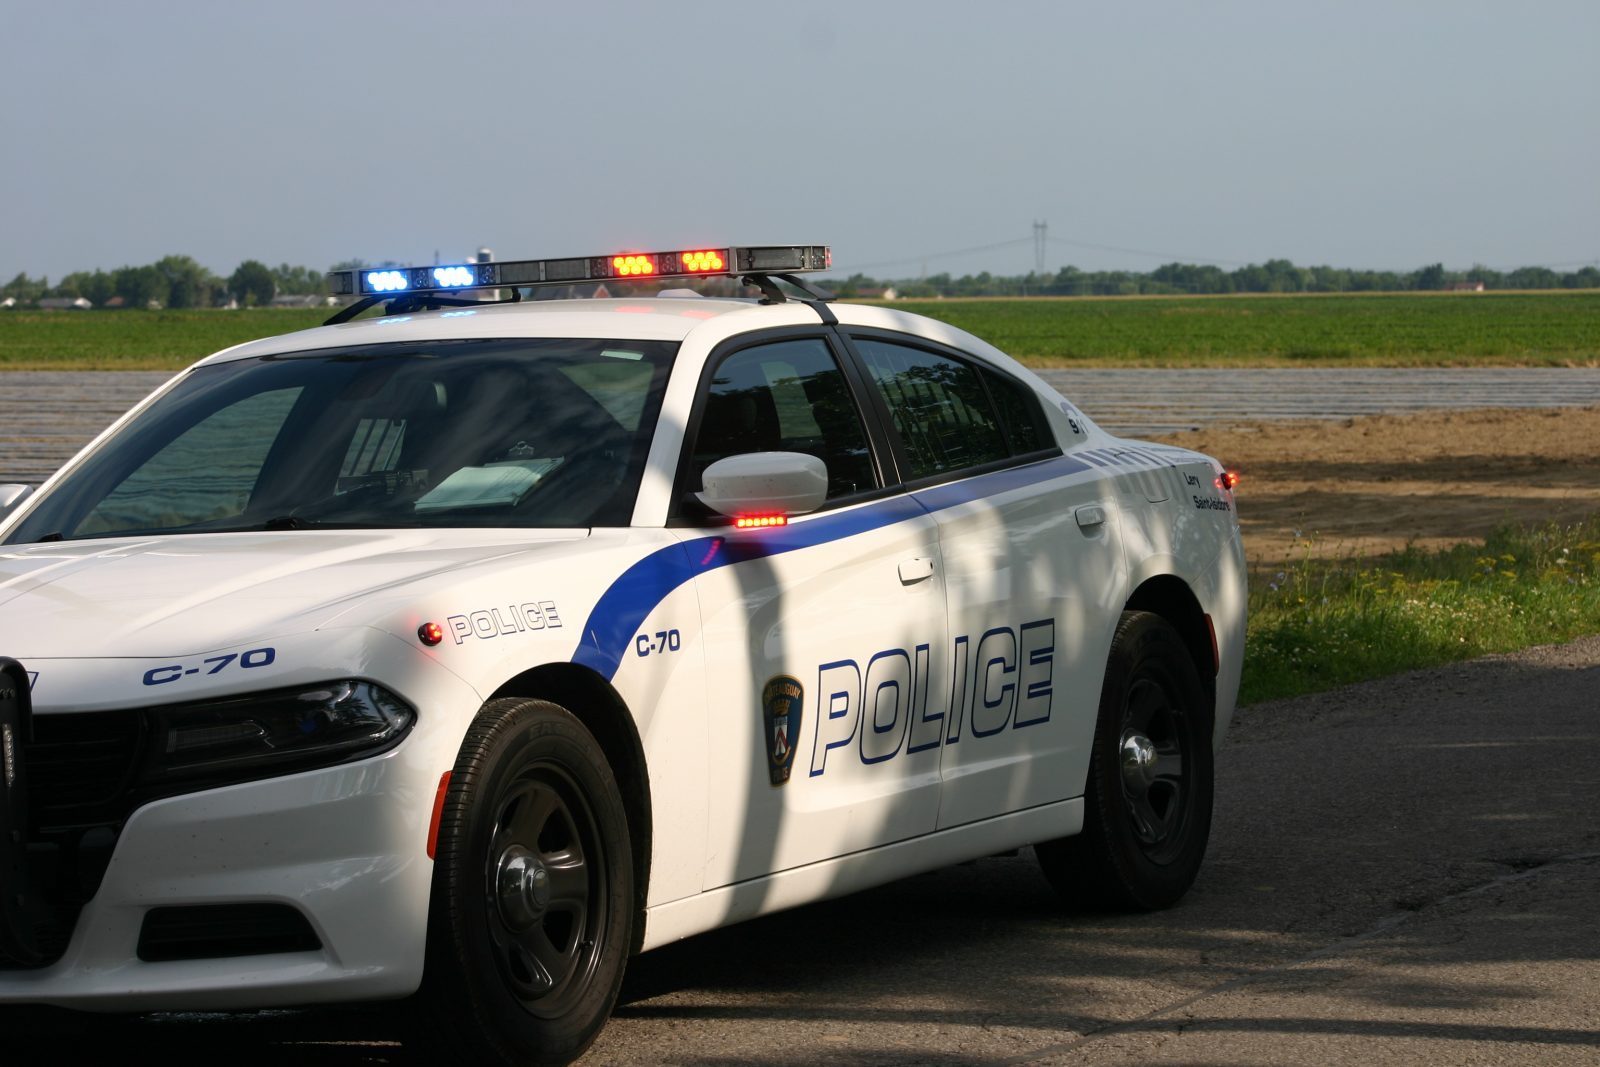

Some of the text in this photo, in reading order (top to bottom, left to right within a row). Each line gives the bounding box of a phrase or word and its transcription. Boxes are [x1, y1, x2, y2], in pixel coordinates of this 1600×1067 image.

[447, 600, 563, 645] POLICE
[636, 629, 681, 658] C-70
[142, 647, 276, 686] C-70
[809, 617, 1055, 778] POLICE
